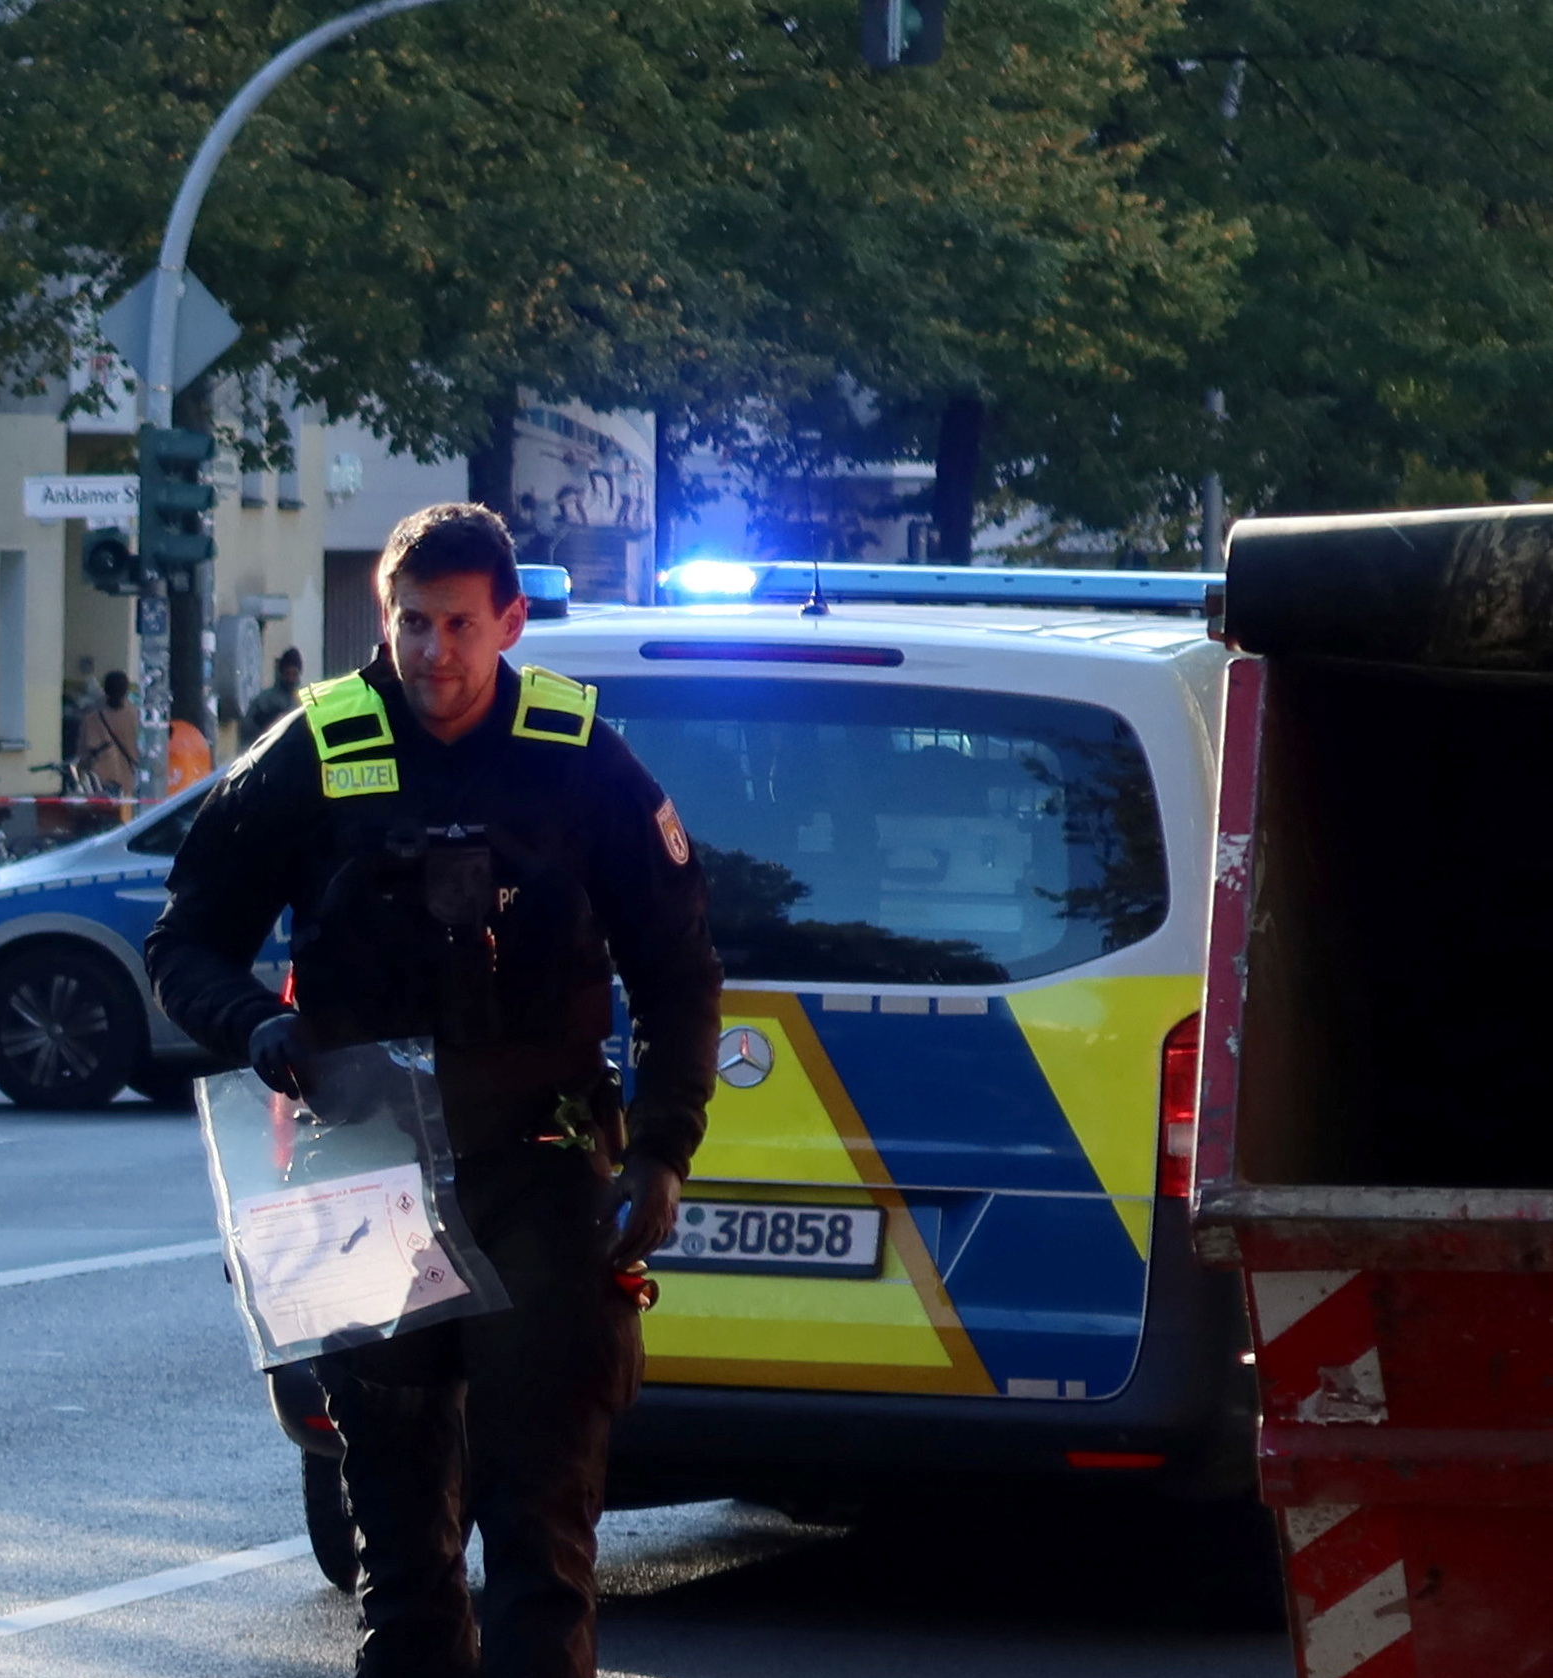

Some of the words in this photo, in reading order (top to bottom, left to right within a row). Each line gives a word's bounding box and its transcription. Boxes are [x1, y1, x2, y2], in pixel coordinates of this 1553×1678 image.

[42, 484, 121, 504] Anklamer
[326, 764, 396, 790] POLIZEI
[710, 1210, 854, 1257] 30858
